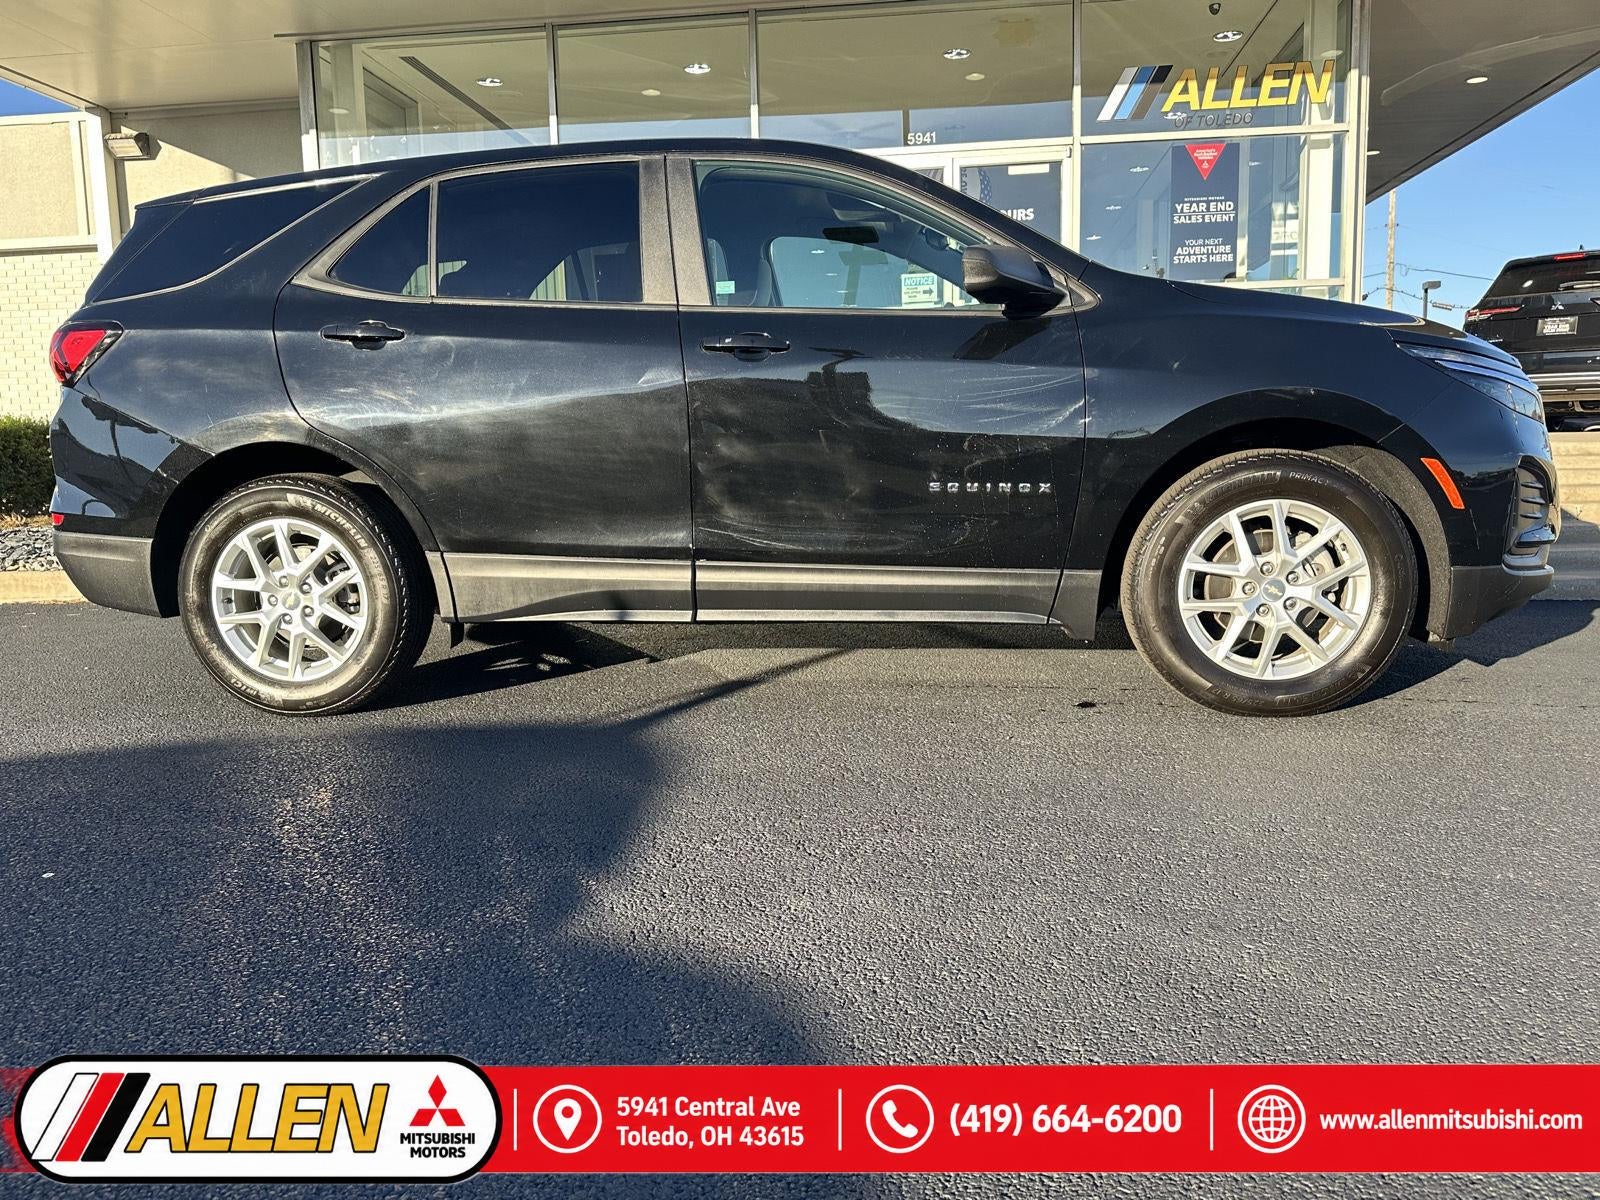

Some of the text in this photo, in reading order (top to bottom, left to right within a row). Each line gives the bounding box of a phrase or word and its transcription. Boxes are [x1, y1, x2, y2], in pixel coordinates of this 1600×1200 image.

[1160, 60, 1335, 112] ALLEN
[1175, 112, 1254, 130] OF TOLEDO
[907, 131, 937, 146] 5941
[1175, 201, 1234, 213] YEAR END
[1000, 208, 1035, 221] URS
[1173, 214, 1236, 224] SALES EVENT
[1176, 245, 1232, 255] ADVENTURE
[1173, 253, 1234, 264] STARTS HERE
[904, 276, 935, 286] NOTICE
[929, 482, 1051, 494] EQUINOX
[314, 503, 369, 548] MICHELIN
